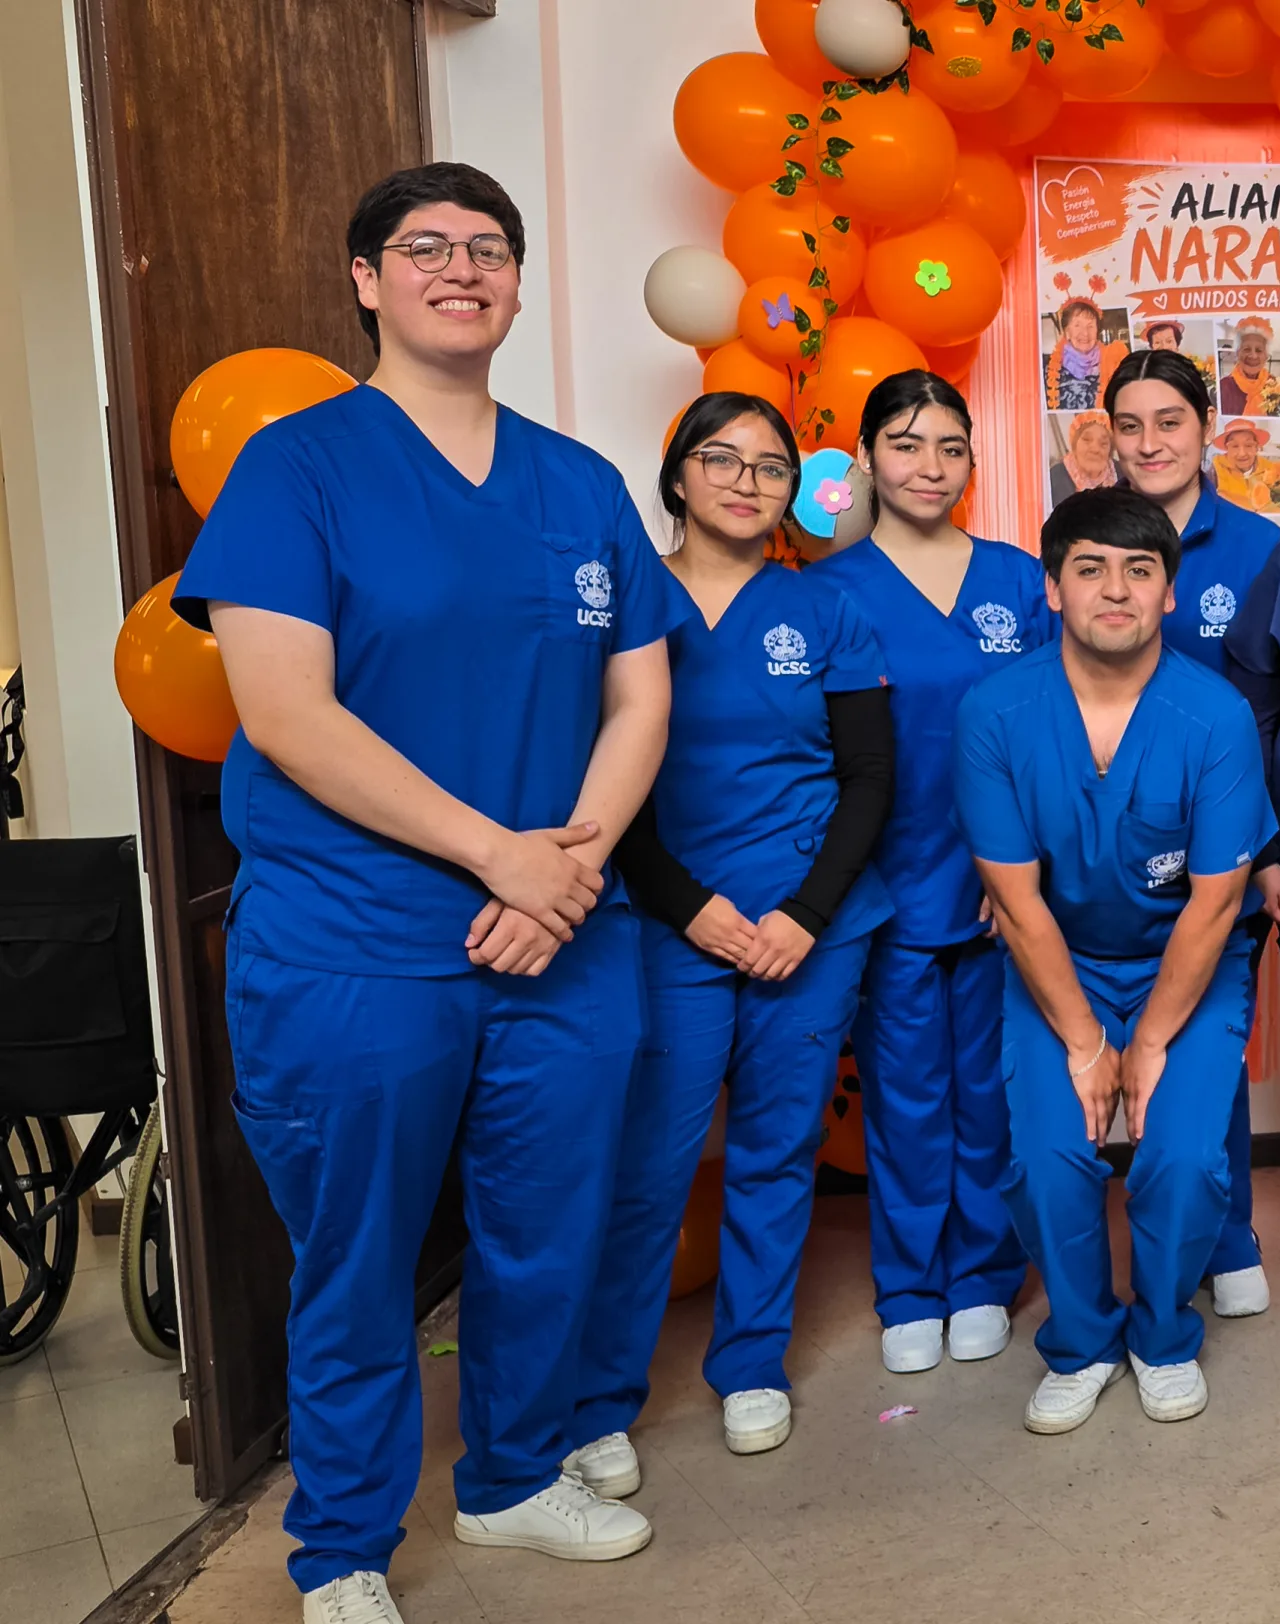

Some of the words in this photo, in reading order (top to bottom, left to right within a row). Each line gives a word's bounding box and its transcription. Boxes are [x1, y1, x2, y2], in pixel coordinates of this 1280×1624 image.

[1061, 185, 1090, 199] Pasión
[1065, 210, 1100, 224] Respeto
[1056, 219, 1117, 240] Compañerismo
[1180, 290, 1249, 311] UNIDOS
[577, 608, 613, 628] UCSC
[1199, 624, 1228, 638] UCS
[980, 638, 1022, 653] UCSC
[767, 661, 811, 676] UCSC
